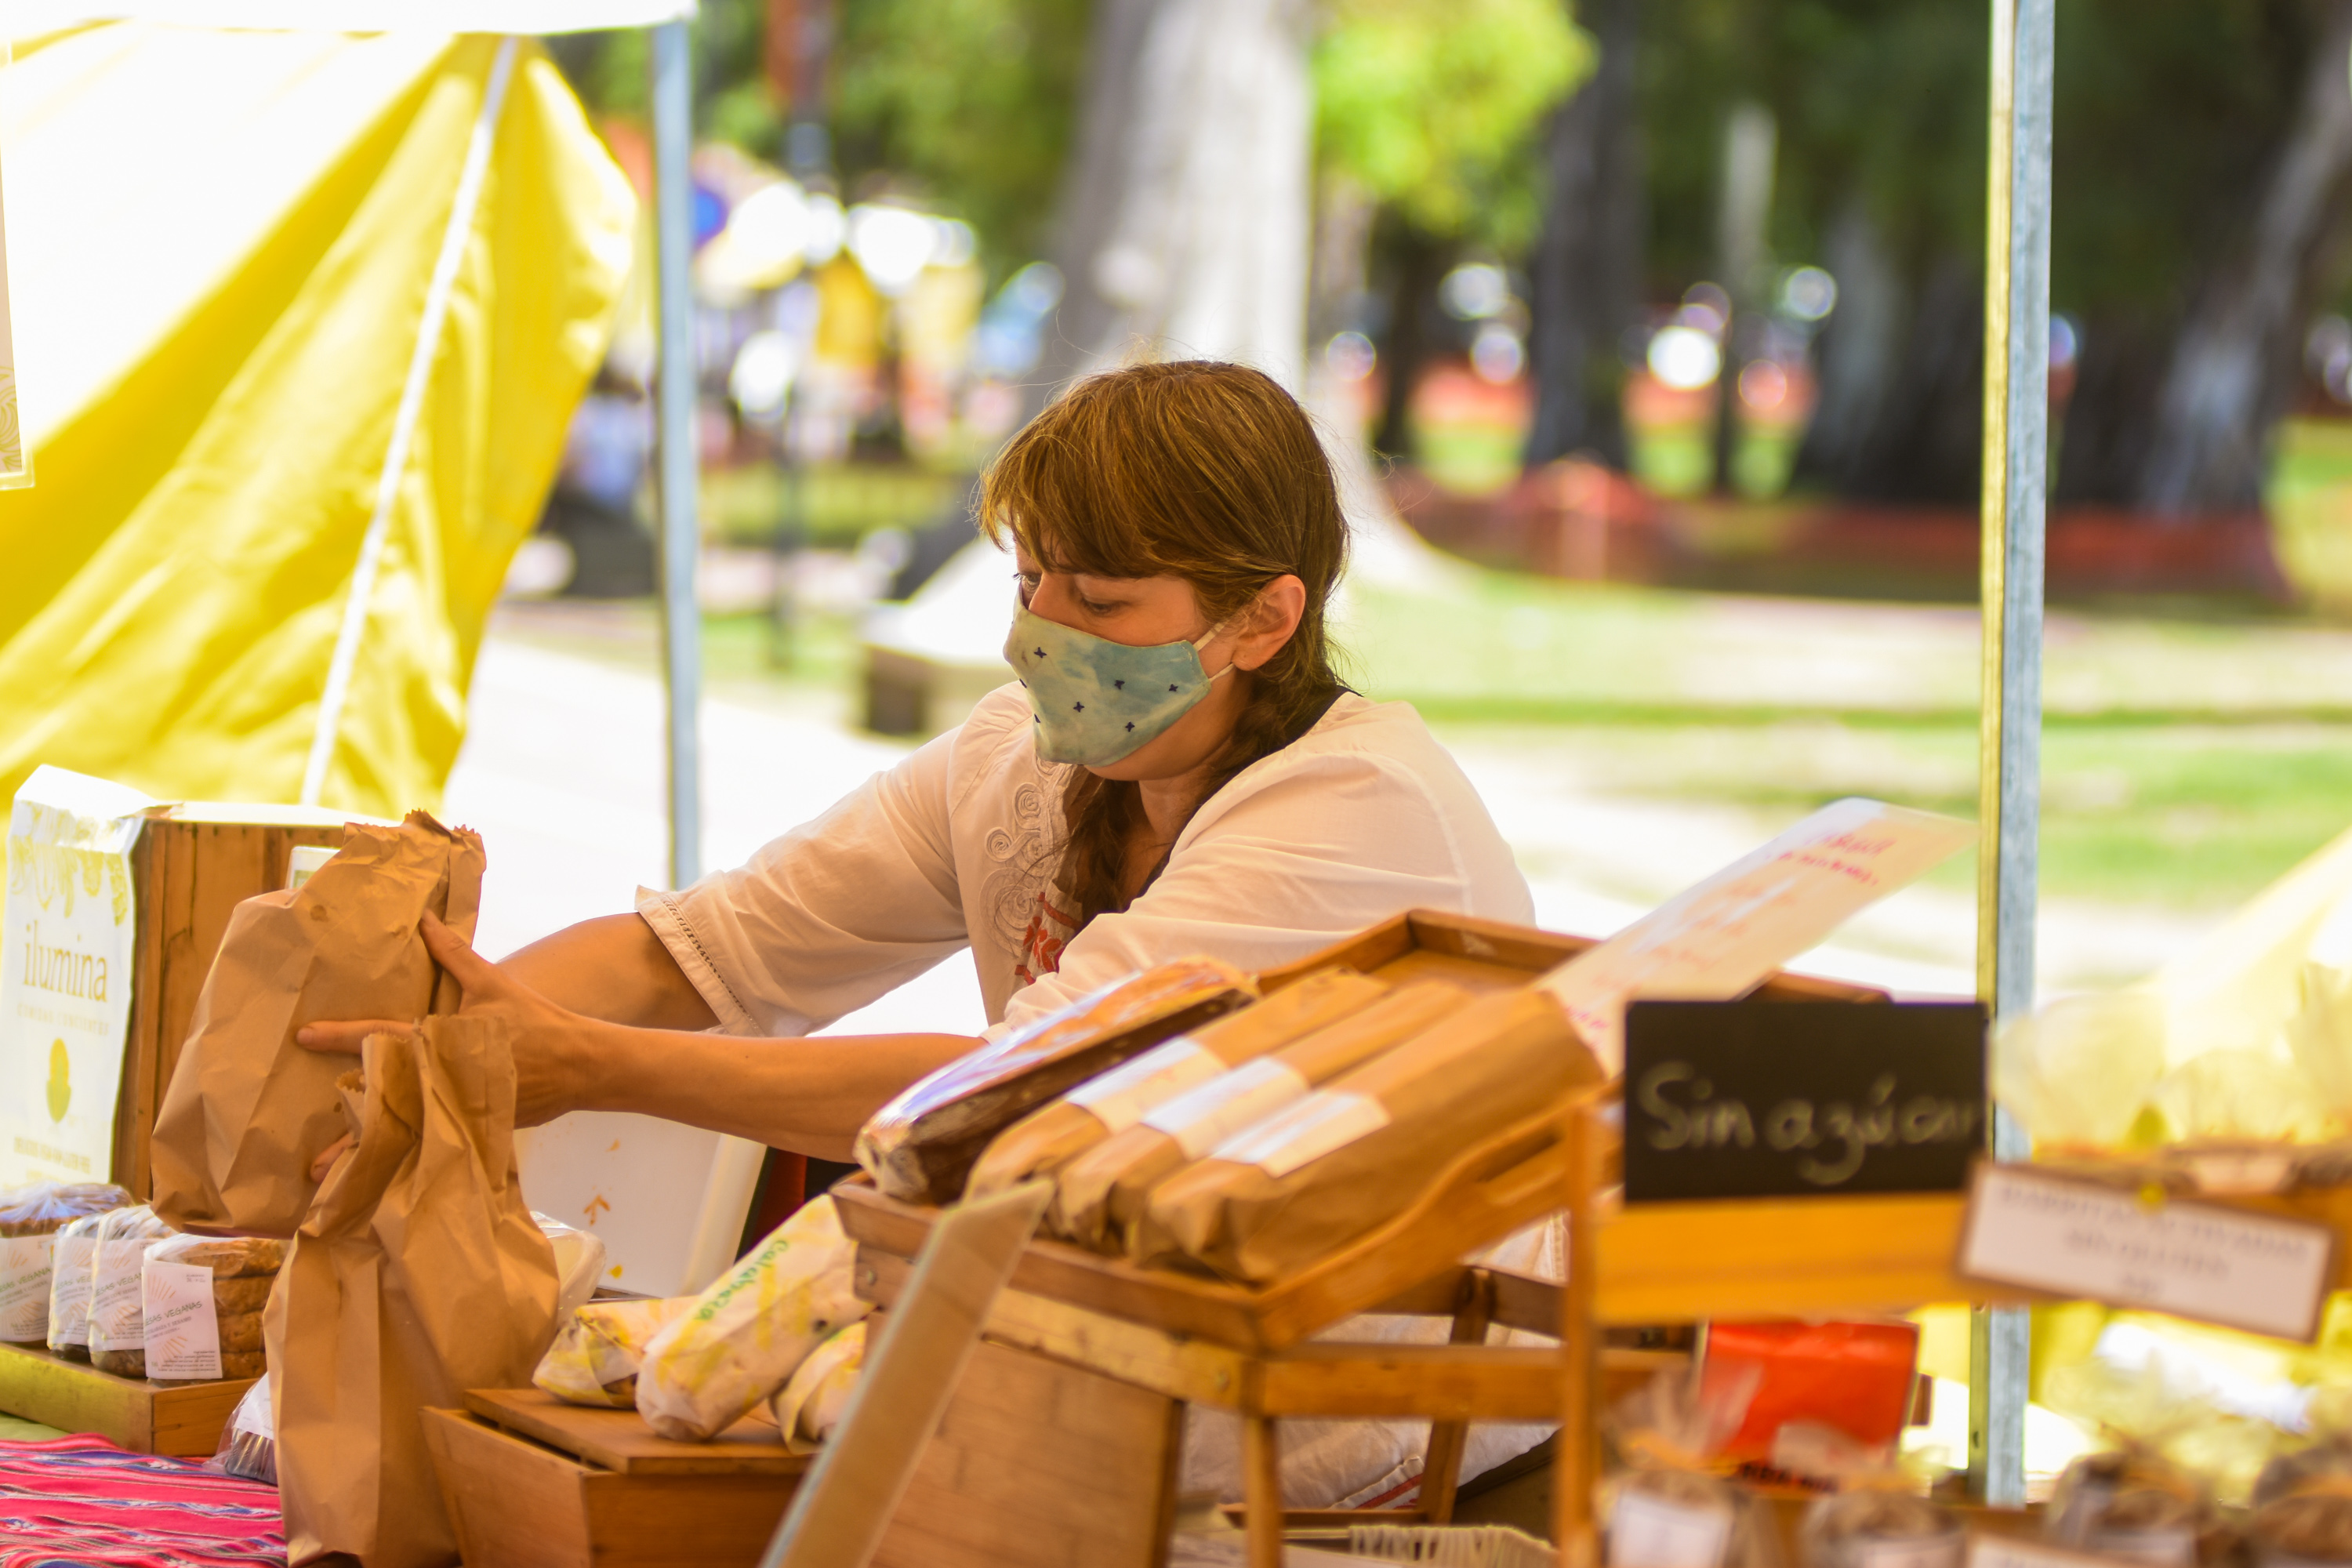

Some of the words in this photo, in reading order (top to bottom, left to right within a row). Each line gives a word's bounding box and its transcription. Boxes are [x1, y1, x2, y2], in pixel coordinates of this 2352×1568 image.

[23, 920, 107, 1003] ilumina
[1638, 1060, 1756, 1151] Sin
[165, 1301, 203, 1319] VEGANAS
